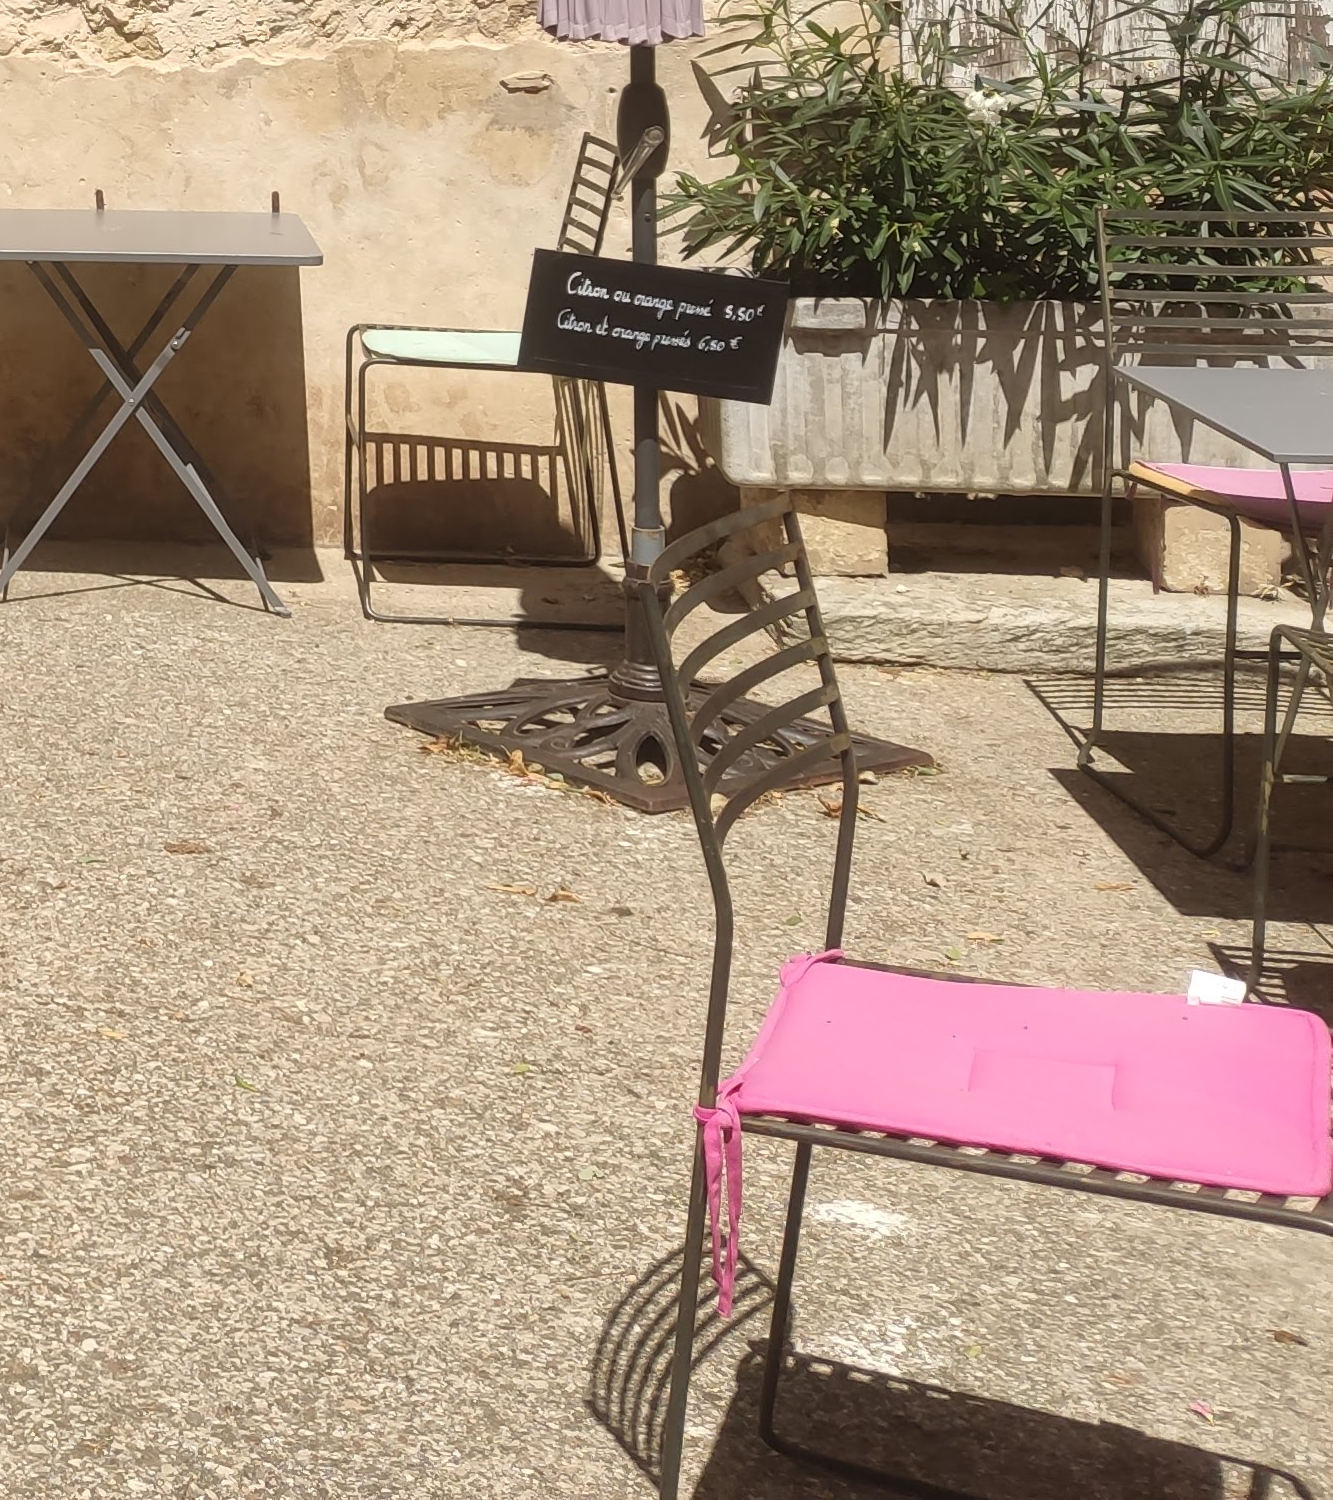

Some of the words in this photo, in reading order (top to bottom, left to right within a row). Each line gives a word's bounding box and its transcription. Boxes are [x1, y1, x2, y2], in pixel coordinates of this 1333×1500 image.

[566, 271, 609, 299] Citron
[613, 289, 631, 304] ou
[634, 293, 674, 320] orange
[676, 298, 714, 321] pressé
[557, 308, 593, 334] Citron
[595, 313, 609, 336] et
[611, 327, 651, 350] orange
[651, 330, 691, 351] pressés
